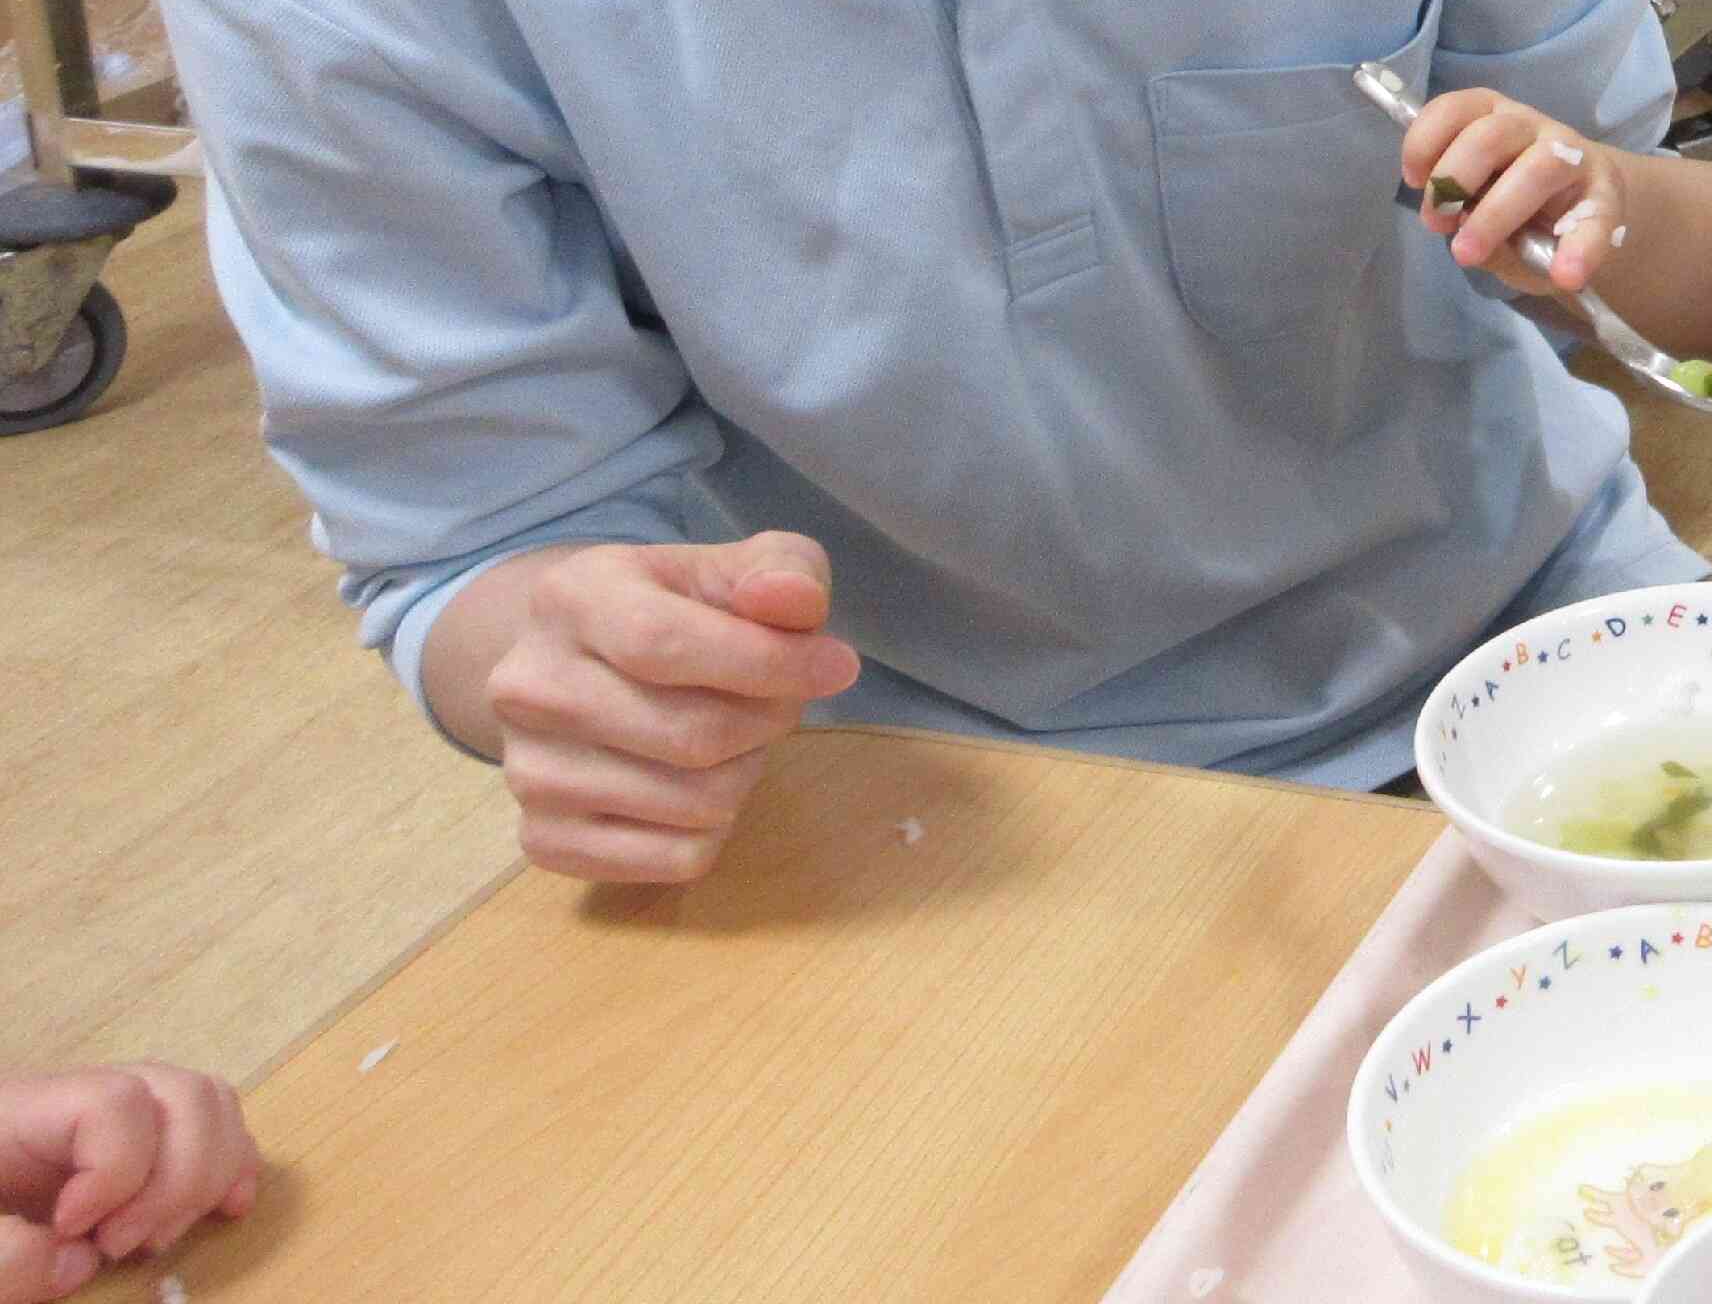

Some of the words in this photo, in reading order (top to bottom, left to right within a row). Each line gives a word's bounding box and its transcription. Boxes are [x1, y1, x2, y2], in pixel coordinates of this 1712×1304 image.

[1517, 643, 1529, 665] B
[1557, 638, 1571, 660] C
[1605, 618, 1626, 637] D
[1667, 605, 1686, 627] E
[1411, 1041, 1431, 1076] W
[1511, 967, 1526, 990] Y
[1553, 940, 1581, 970] Z
[1641, 939, 1659, 963] A
[1696, 924, 1712, 949] B
